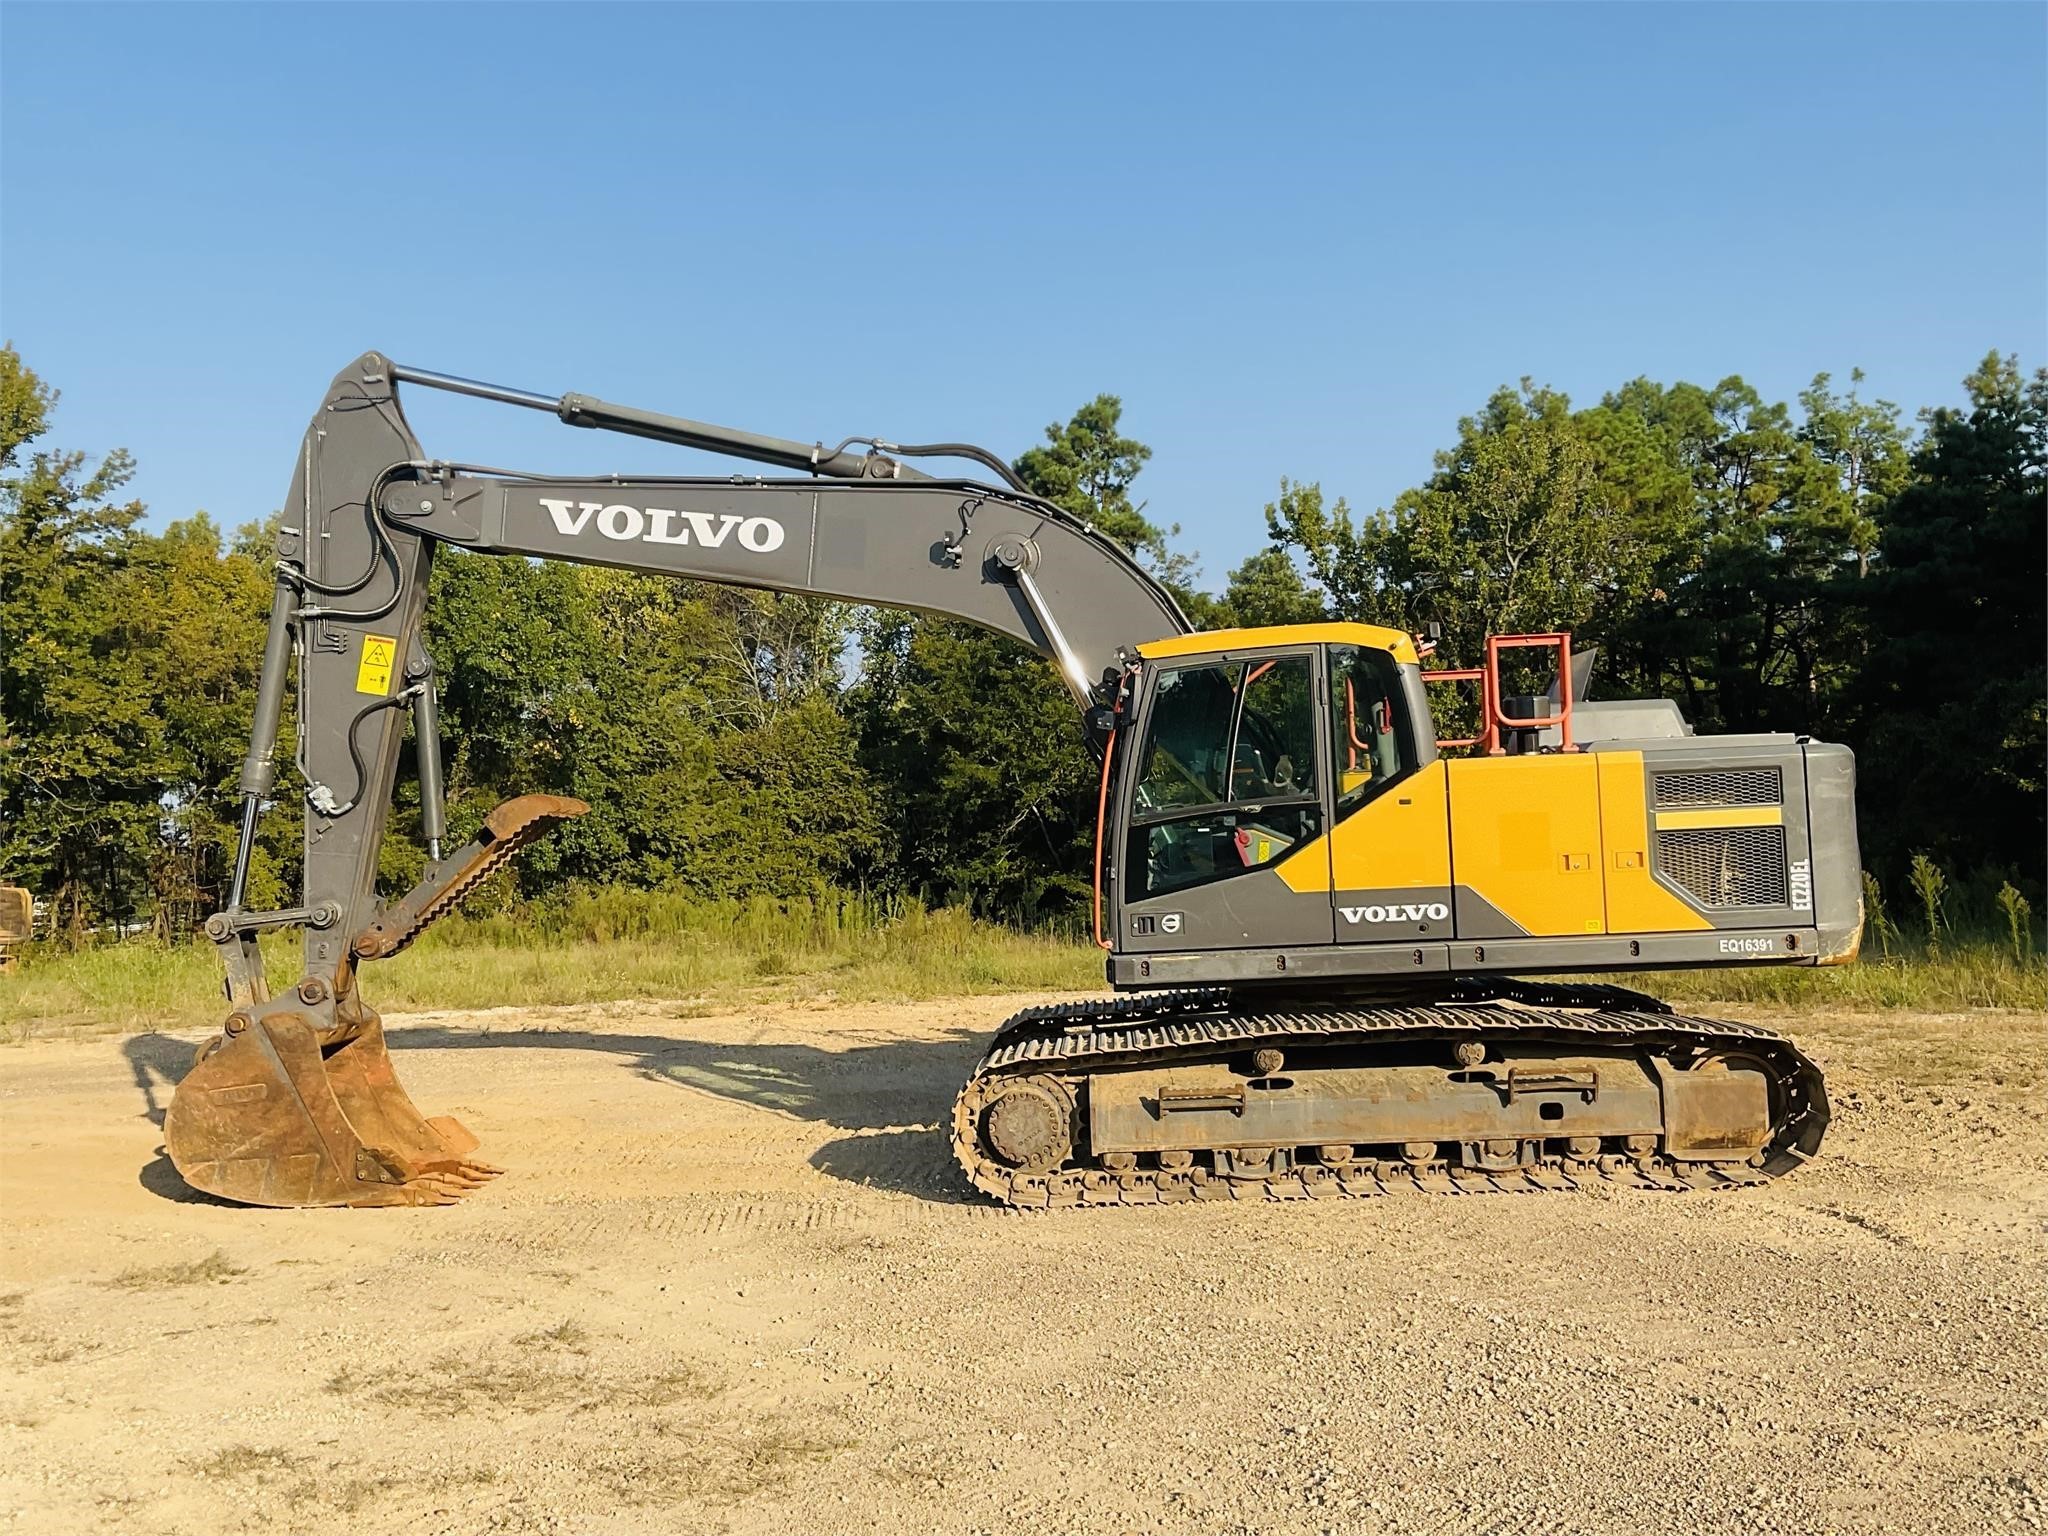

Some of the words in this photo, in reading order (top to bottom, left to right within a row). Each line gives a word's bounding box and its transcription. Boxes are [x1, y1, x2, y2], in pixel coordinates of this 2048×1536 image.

[539, 499, 785, 553] VOLVO
[1790, 859, 1811, 911] EC220EL
[1338, 903, 1449, 924] VOLVO
[1719, 939, 1773, 953] EQ16391
